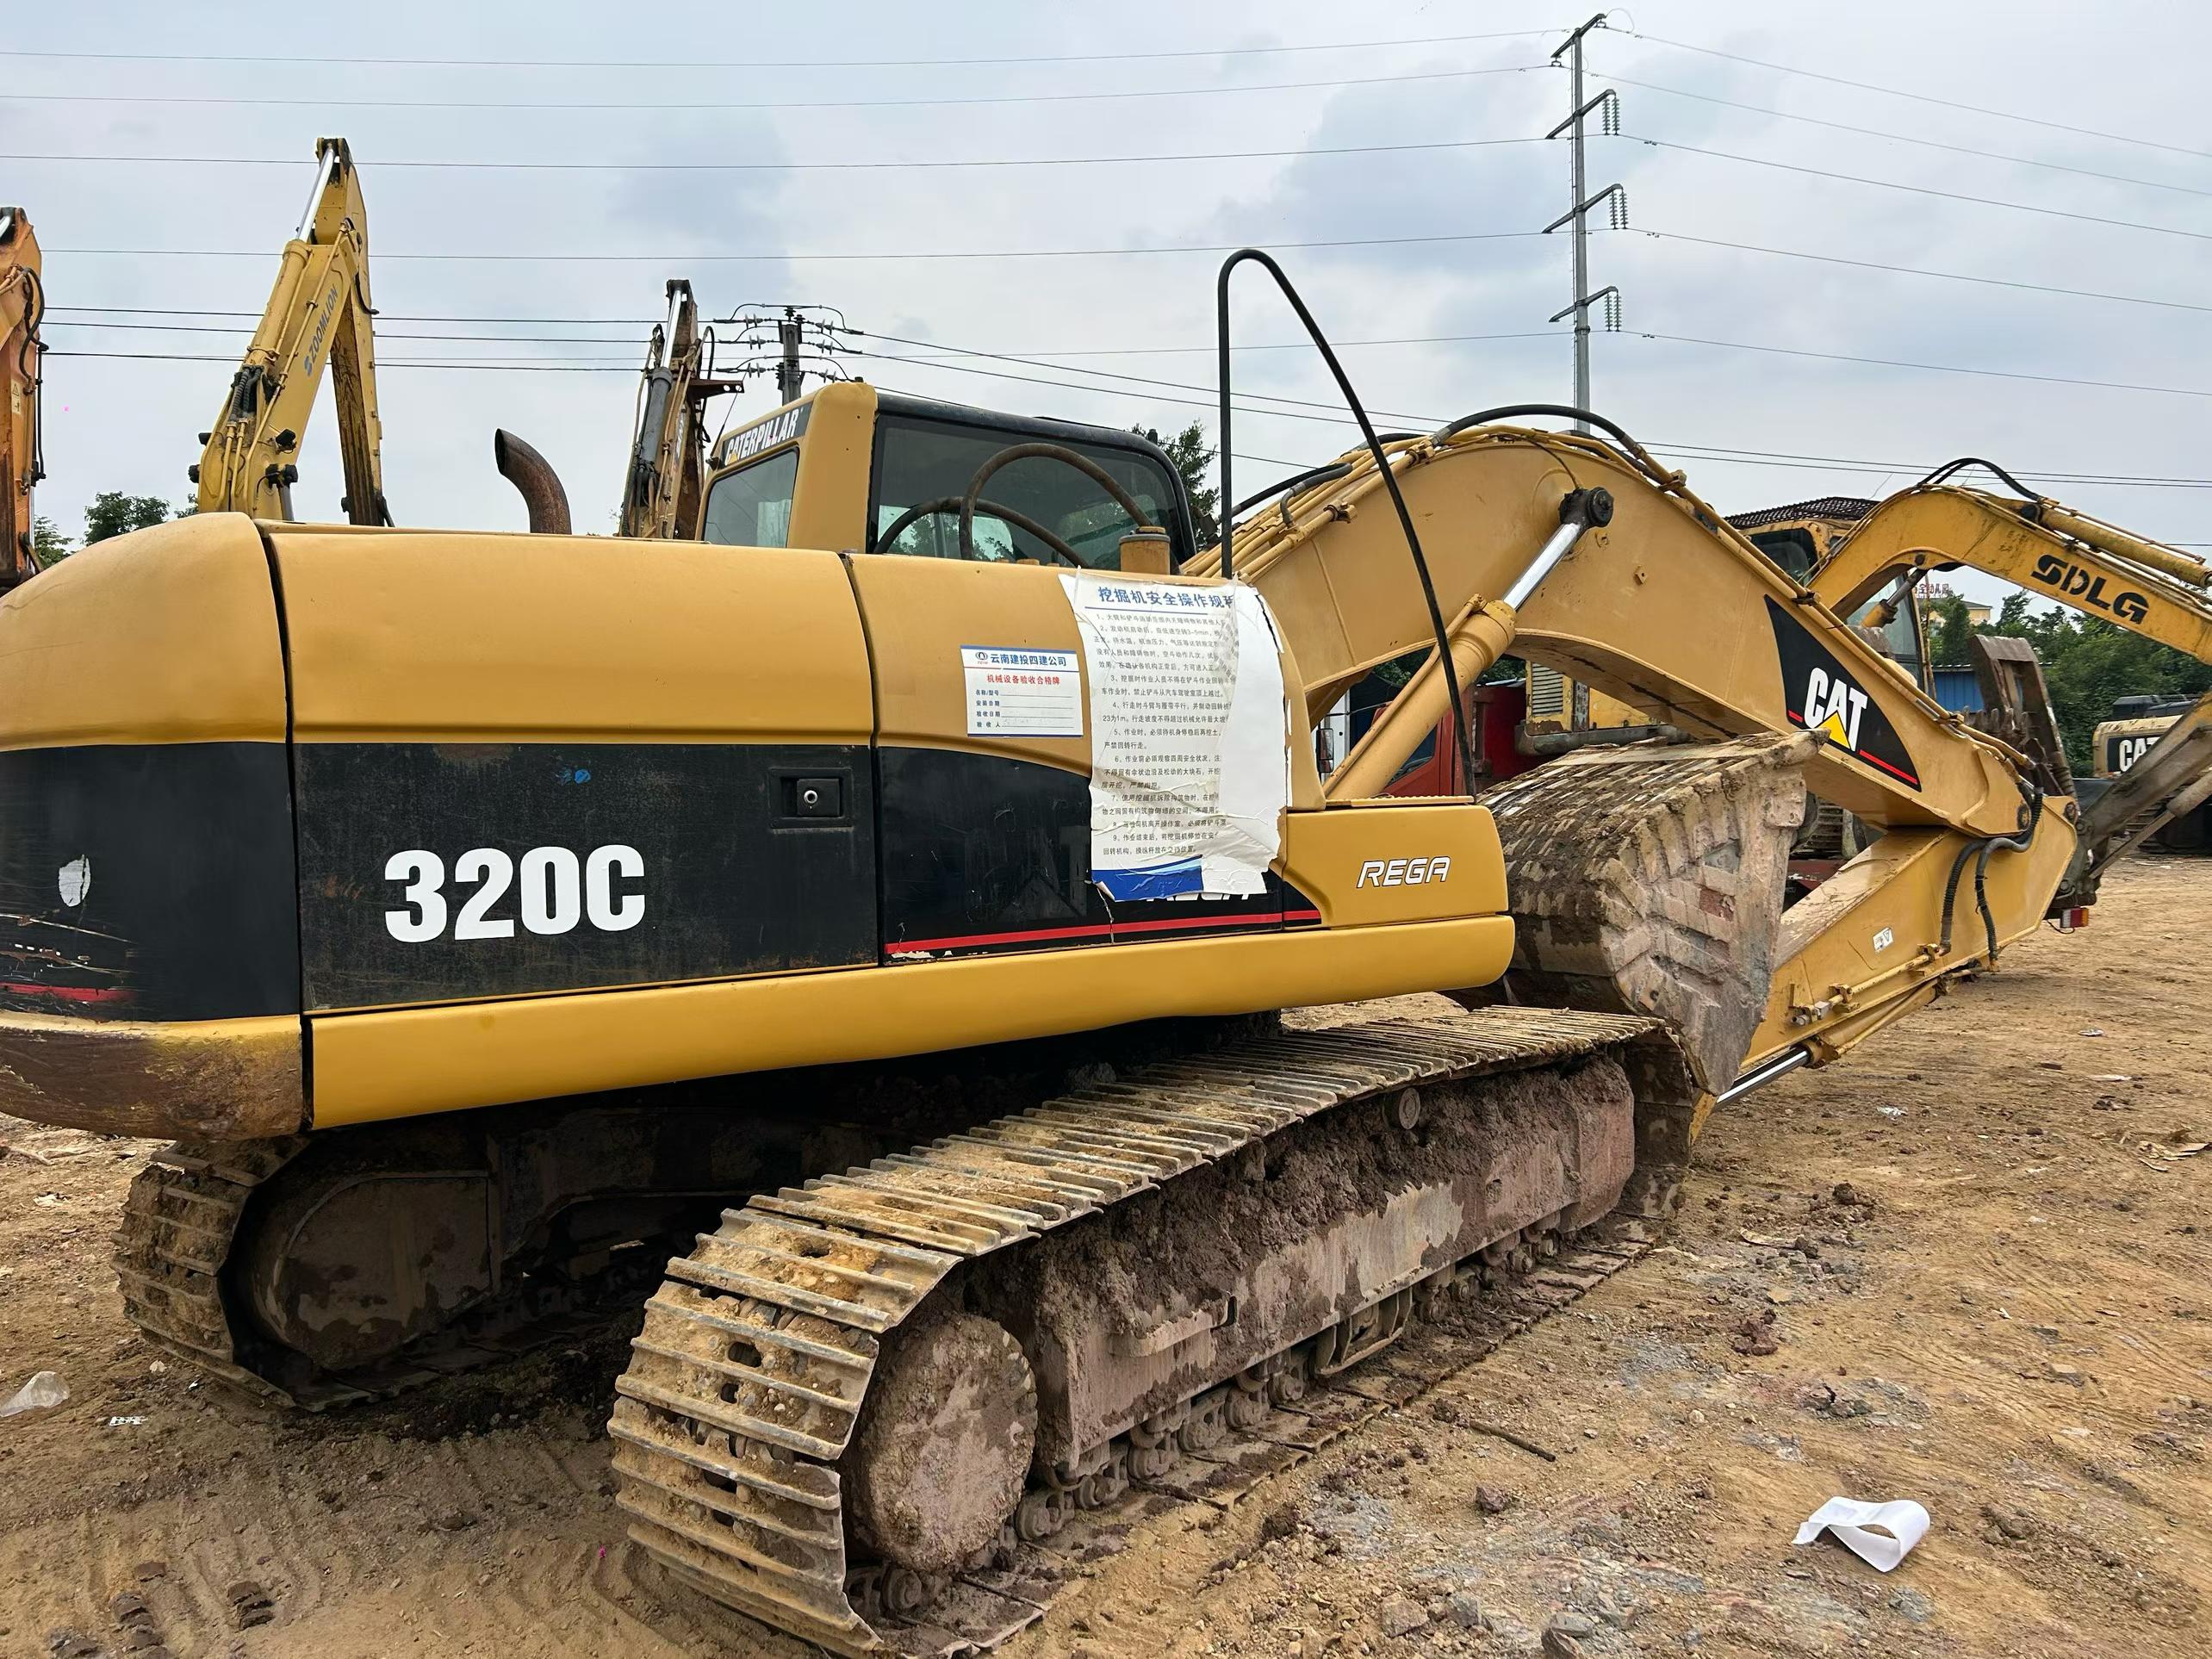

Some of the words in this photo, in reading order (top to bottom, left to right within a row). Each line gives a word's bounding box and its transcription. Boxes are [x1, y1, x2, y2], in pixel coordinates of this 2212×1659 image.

[309, 283, 339, 363] ZOOMLION
[724, 408, 799, 466] CATERPILLAR
[2030, 554, 2150, 624] SDLG
[987, 674, 1060, 686] 机械设备验收合格牌
[990, 653, 1067, 667] 云南建投四建公司
[1805, 667, 1868, 752] CAT
[384, 843, 646, 944] 320C
[1356, 855, 1451, 889] REGA
